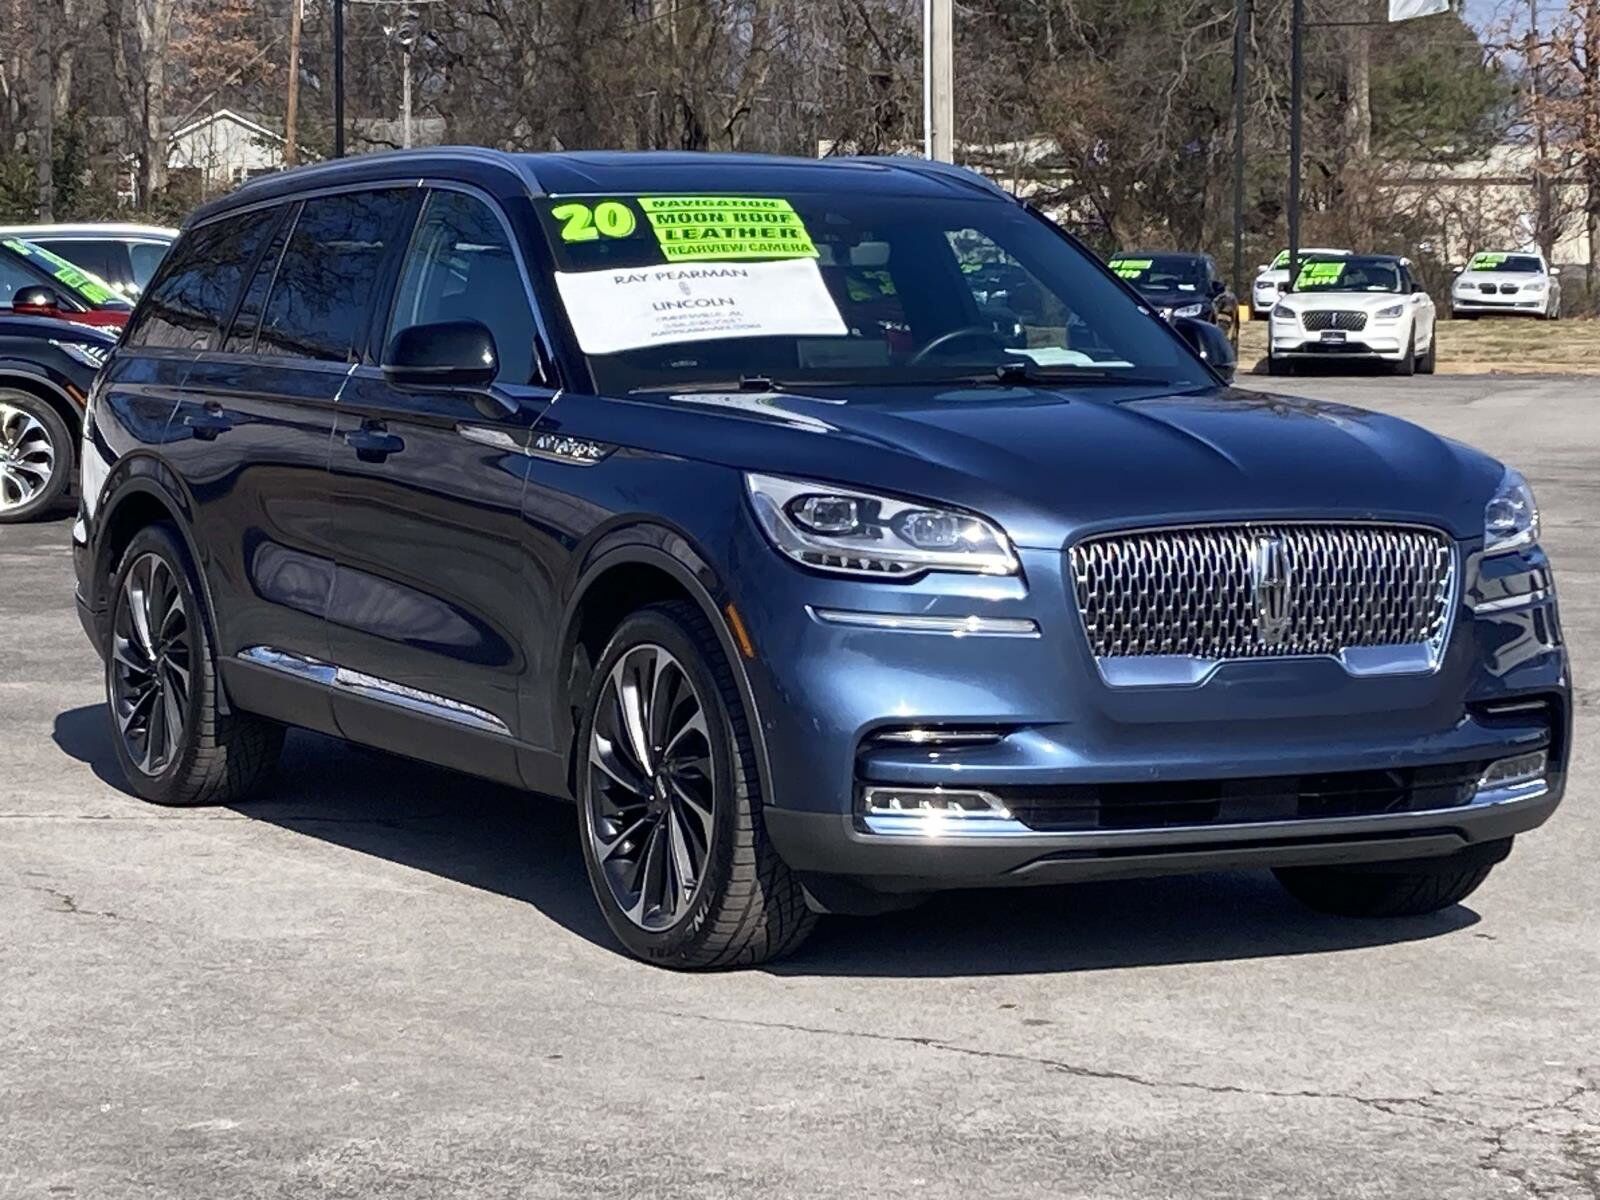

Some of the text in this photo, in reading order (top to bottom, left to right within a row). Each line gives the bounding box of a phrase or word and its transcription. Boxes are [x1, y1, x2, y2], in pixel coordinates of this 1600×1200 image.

[651, 199, 779, 209] NAVIGATION
[551, 201, 636, 243] 20
[655, 212, 794, 225] MOON ROOF
[664, 226, 801, 241] LEATHER
[666, 242, 812, 256] REARVIEW CAMERA
[613, 268, 749, 285] RAY PEARMAN
[652, 297, 735, 312] LINCOLN
